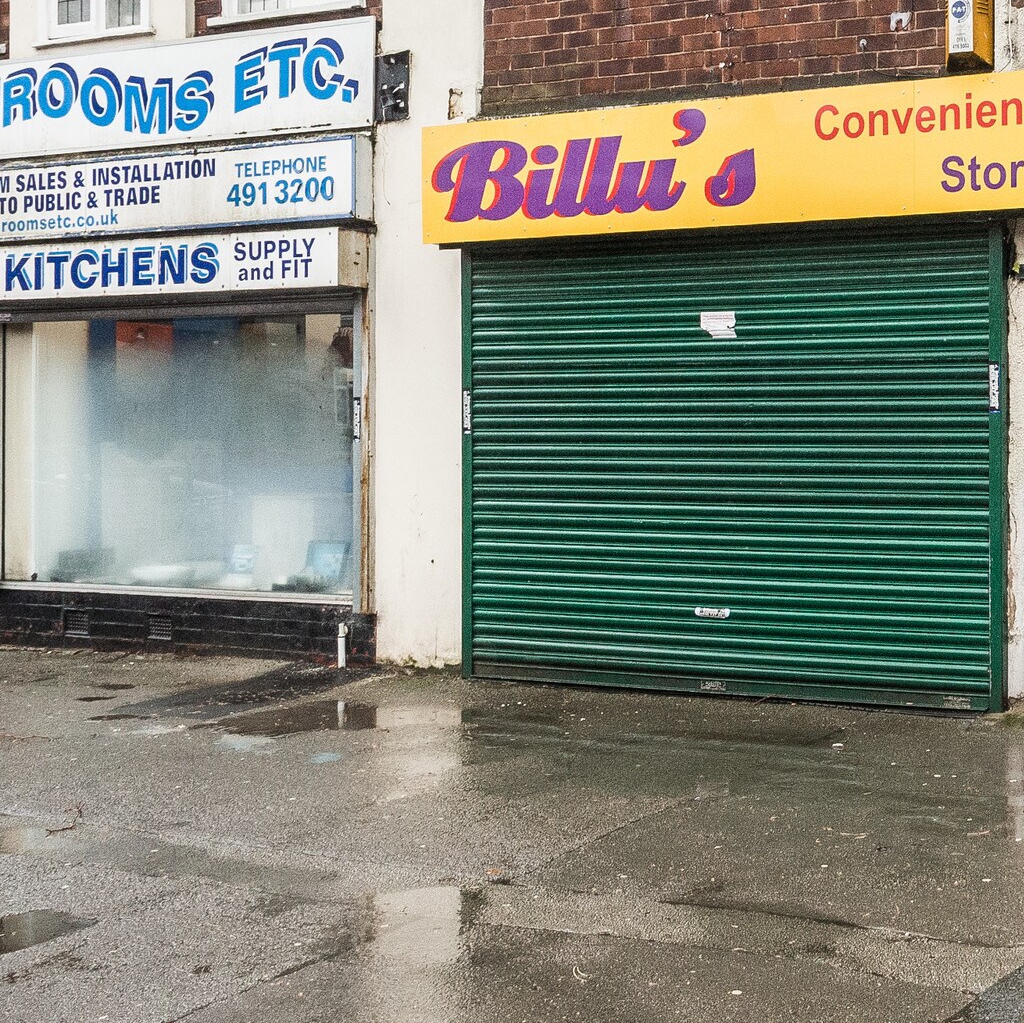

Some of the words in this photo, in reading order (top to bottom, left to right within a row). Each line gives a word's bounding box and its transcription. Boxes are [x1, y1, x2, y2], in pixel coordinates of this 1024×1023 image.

[2, 62, 214, 135] ROOMS
[234, 38, 359, 113] ETC.
[16, 171, 67, 193] SALES
[73, 170, 85, 189] &
[92, 158, 216, 187] INSTALLATION
[235, 155, 327, 178] TELEPHONE
[0, 196, 18, 215] TO
[23, 191, 82, 213] PUBLIC
[87, 191, 98, 209] &
[104, 185, 160, 208] TRADE
[226, 181, 267, 207] 491
[274, 175, 335, 204] 3200
[2, 209, 118, 232] roomsetc.co.uk
[234, 238, 315, 262] SUPPLY
[4, 242, 220, 291] KITCHENS
[238, 260, 274, 281] and
[281, 258, 313, 279] FIT
